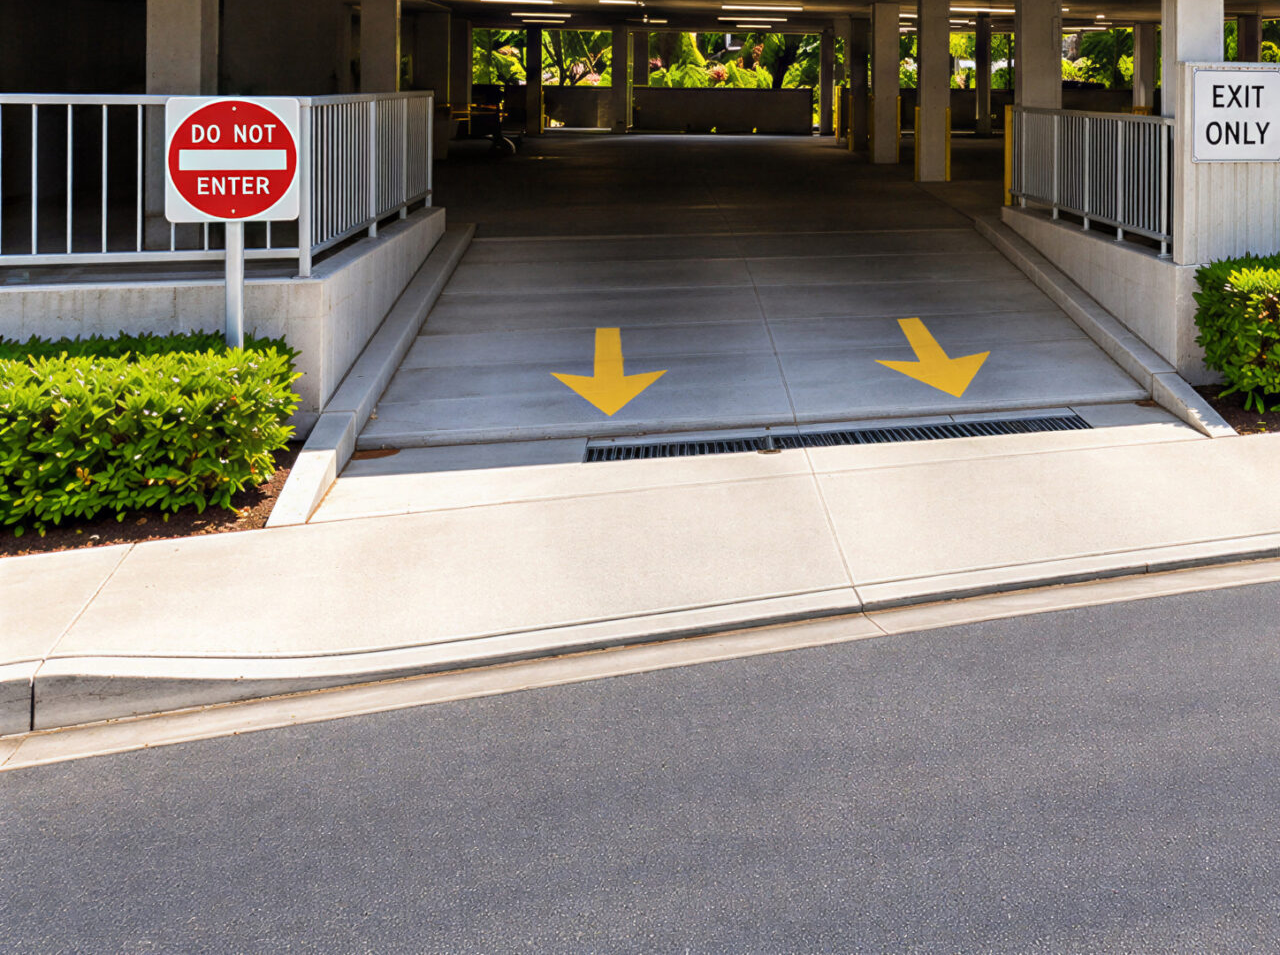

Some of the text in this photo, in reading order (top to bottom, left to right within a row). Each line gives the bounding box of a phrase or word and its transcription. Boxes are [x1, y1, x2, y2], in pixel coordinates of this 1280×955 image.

[1213, 85, 1264, 108] EXIT
[191, 124, 276, 143] DO NOT
[1206, 121, 1270, 145] ONLY
[197, 176, 270, 195] ENTER
